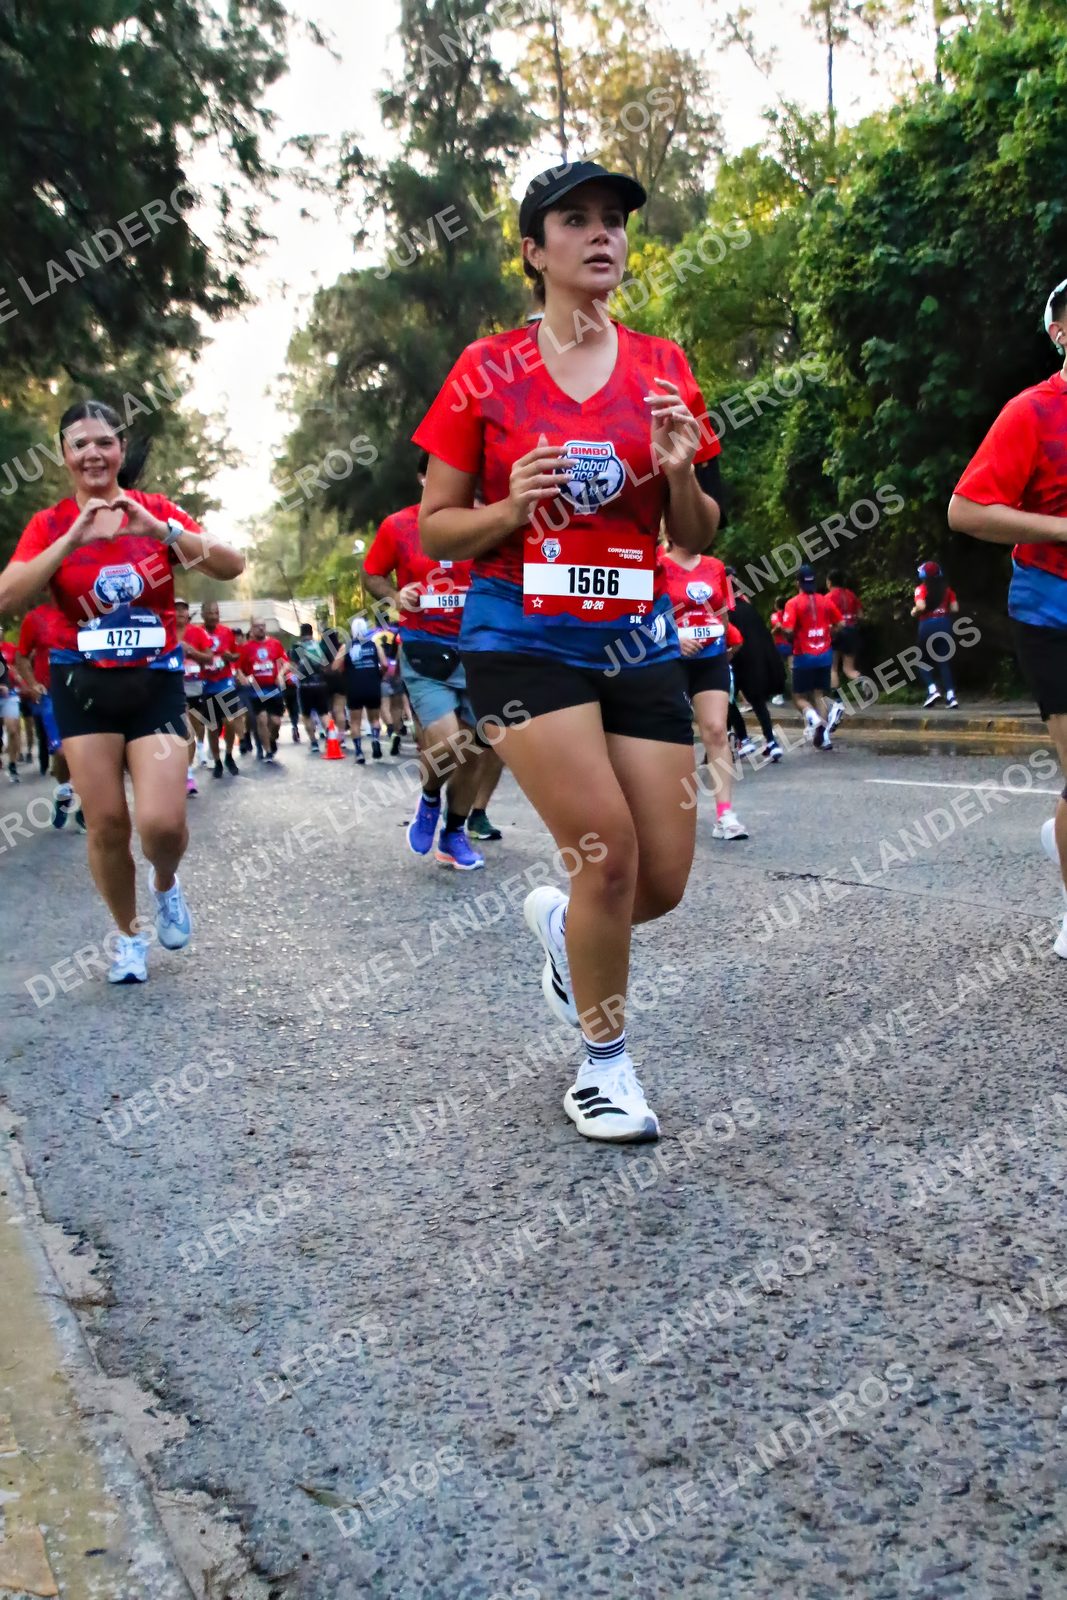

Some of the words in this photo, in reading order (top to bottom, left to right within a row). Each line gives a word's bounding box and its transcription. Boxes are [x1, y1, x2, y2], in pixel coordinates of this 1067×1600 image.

[571, 447, 608, 456] BIMBO
[568, 567, 619, 596] 1566
[630, 615, 642, 624] 5K
[694, 627, 711, 637] 1515
[107, 630, 140, 646] 4727
